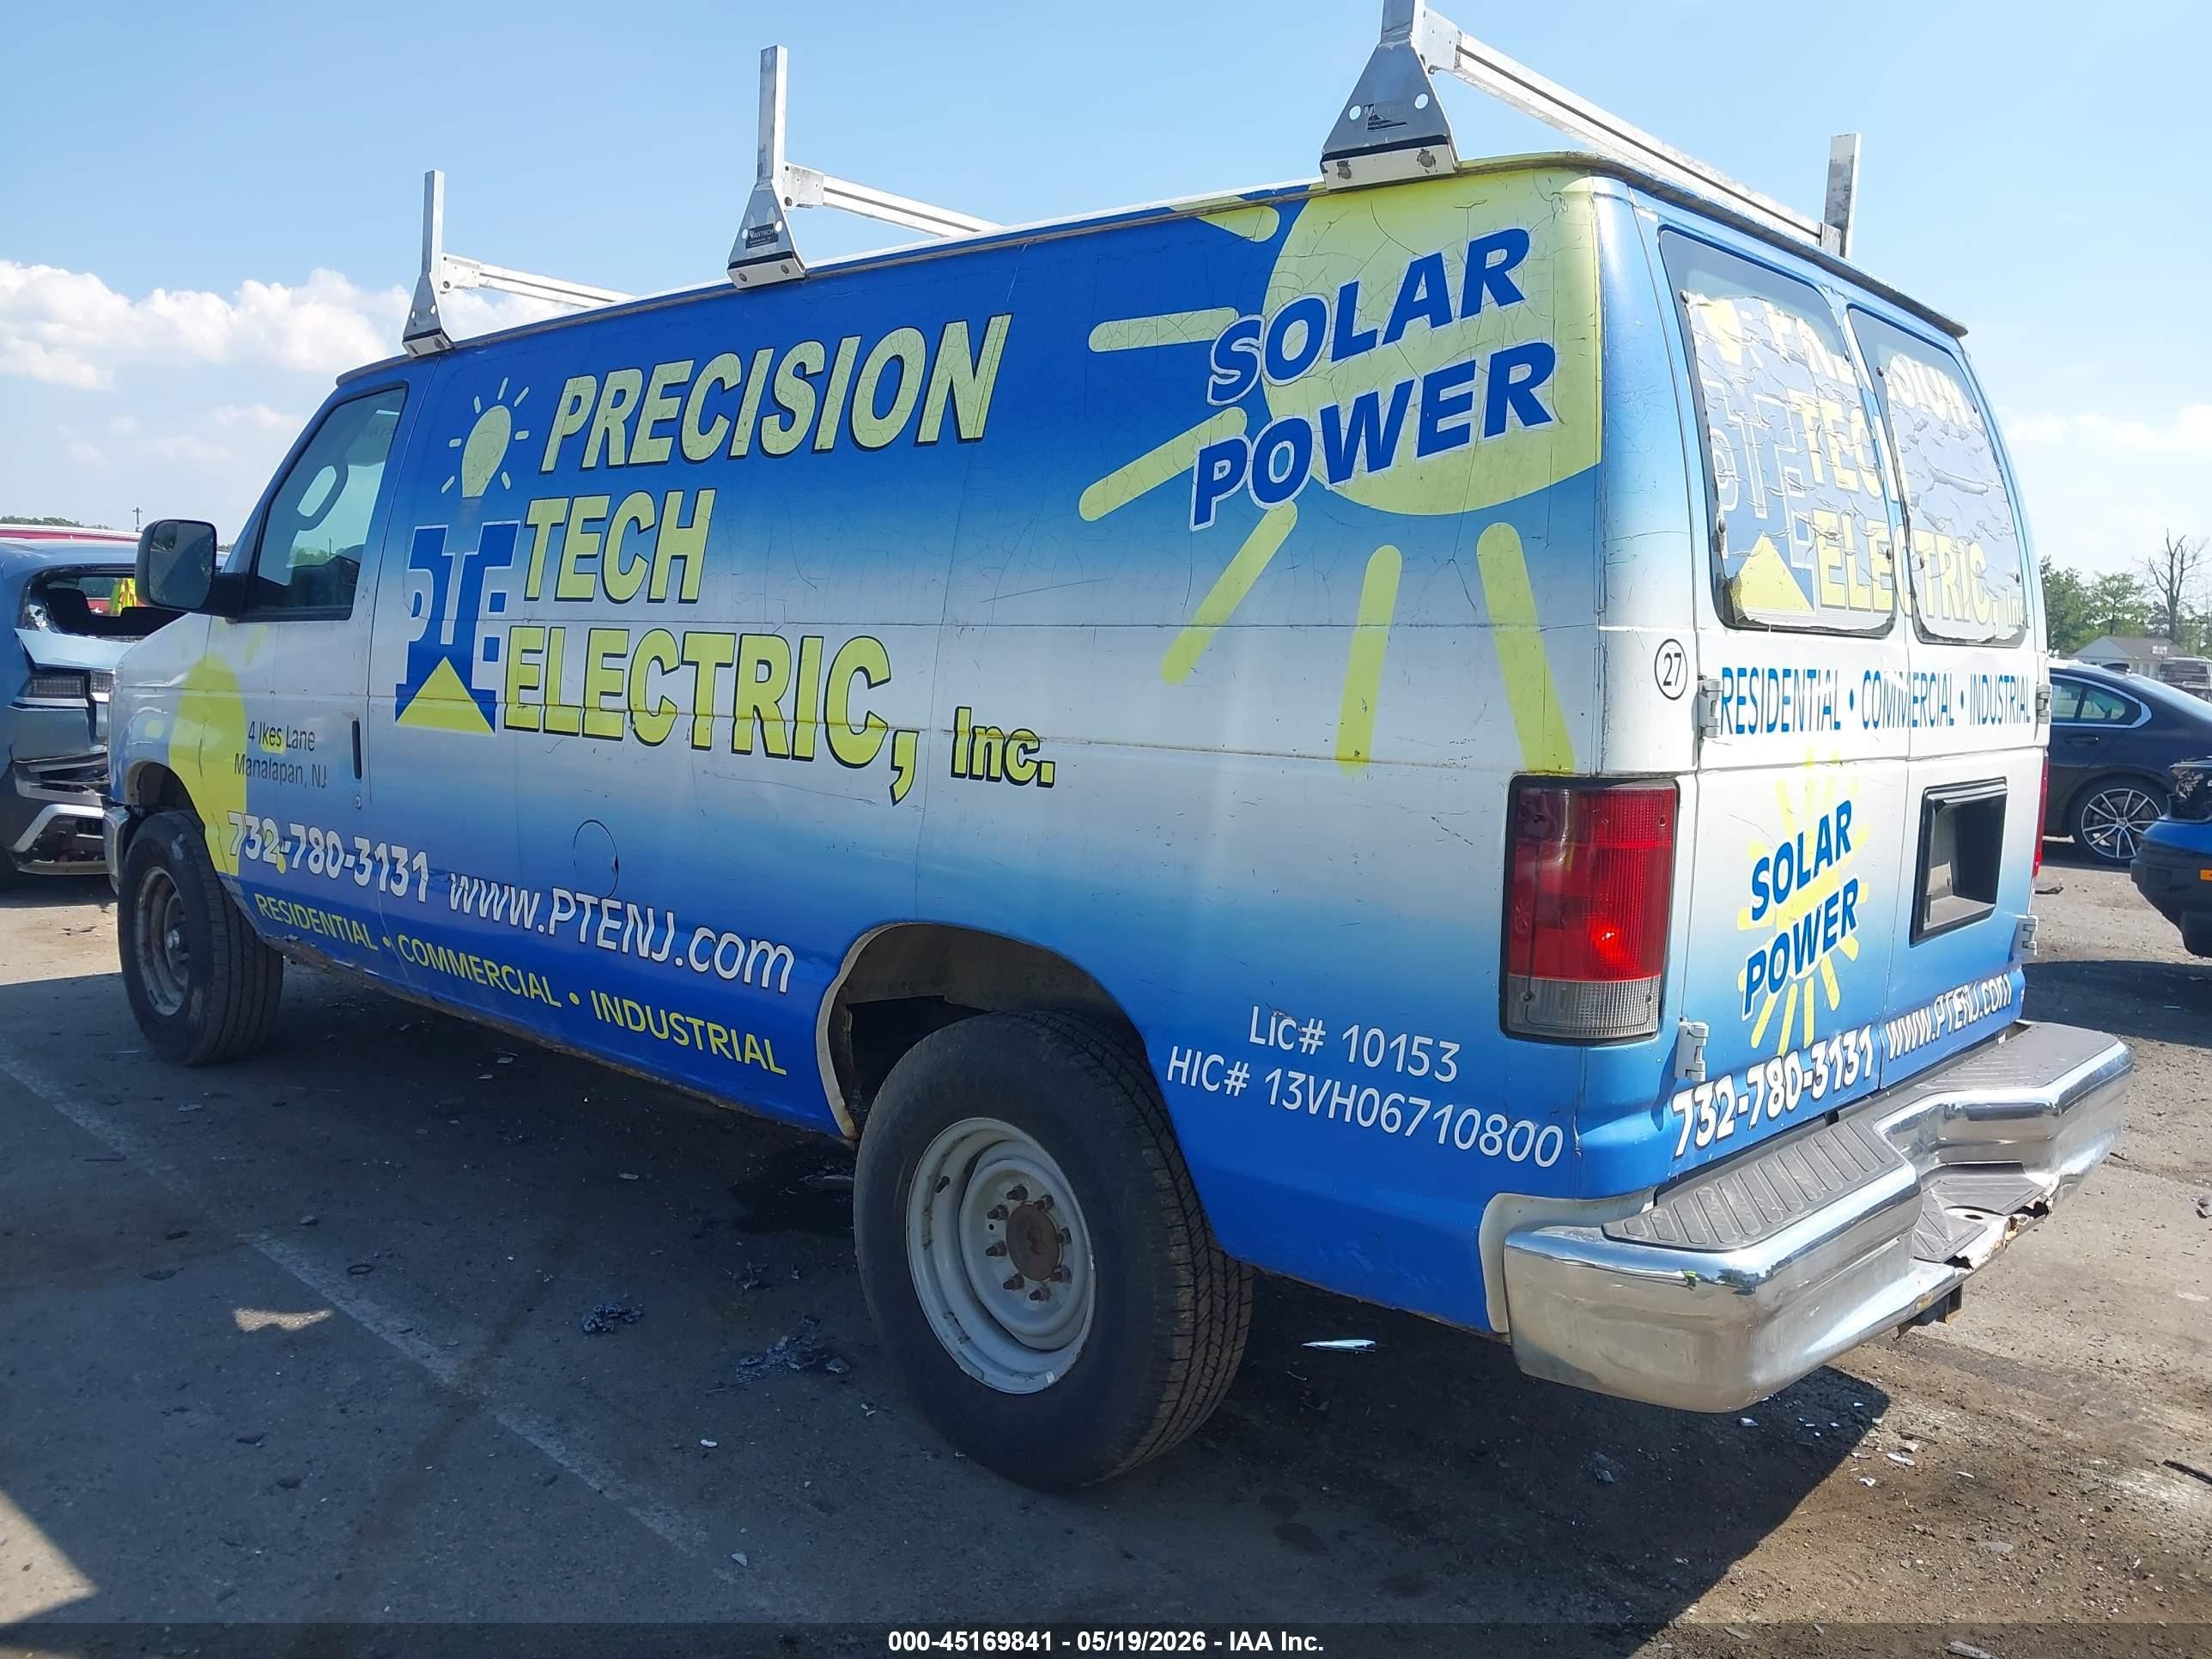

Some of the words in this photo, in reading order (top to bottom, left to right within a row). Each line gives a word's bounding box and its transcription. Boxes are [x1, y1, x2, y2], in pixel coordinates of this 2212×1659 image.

[1207, 226, 1531, 407] SOLAR
[539, 313, 1014, 475] PRECISION
[1189, 341, 1558, 532] POWER
[524, 488, 716, 605] TECH
[503, 626, 919, 806] ELECTRIC,
[950, 706, 1056, 788] Inc.
[1664, 652, 1683, 687] 27
[1720, 666, 1842, 735] RESIDENTIAL
[1969, 673, 2032, 726] INDUSTRIAL
[234, 752, 307, 790] Manalapan,
[311, 763, 327, 790] NJ
[247, 720, 256, 744] 4
[258, 721, 283, 748] Ikes
[286, 725, 316, 752] Lane
[226, 811, 429, 903] 732-780-3131
[1750, 799, 1853, 923] SOLAR
[254, 893, 379, 951] RESIDENTIAL
[398, 934, 562, 1008] COMMERCIAL
[591, 989, 788, 1076] INDUSTRIAL
[1742, 876, 1859, 1018] POWER
[1166, 1044, 1251, 1097] HIC#
[1263, 1067, 1565, 1169] 13VH06710800
[1341, 1024, 1461, 1084] 10153
[1671, 1024, 1875, 1161] 732-780-3131
